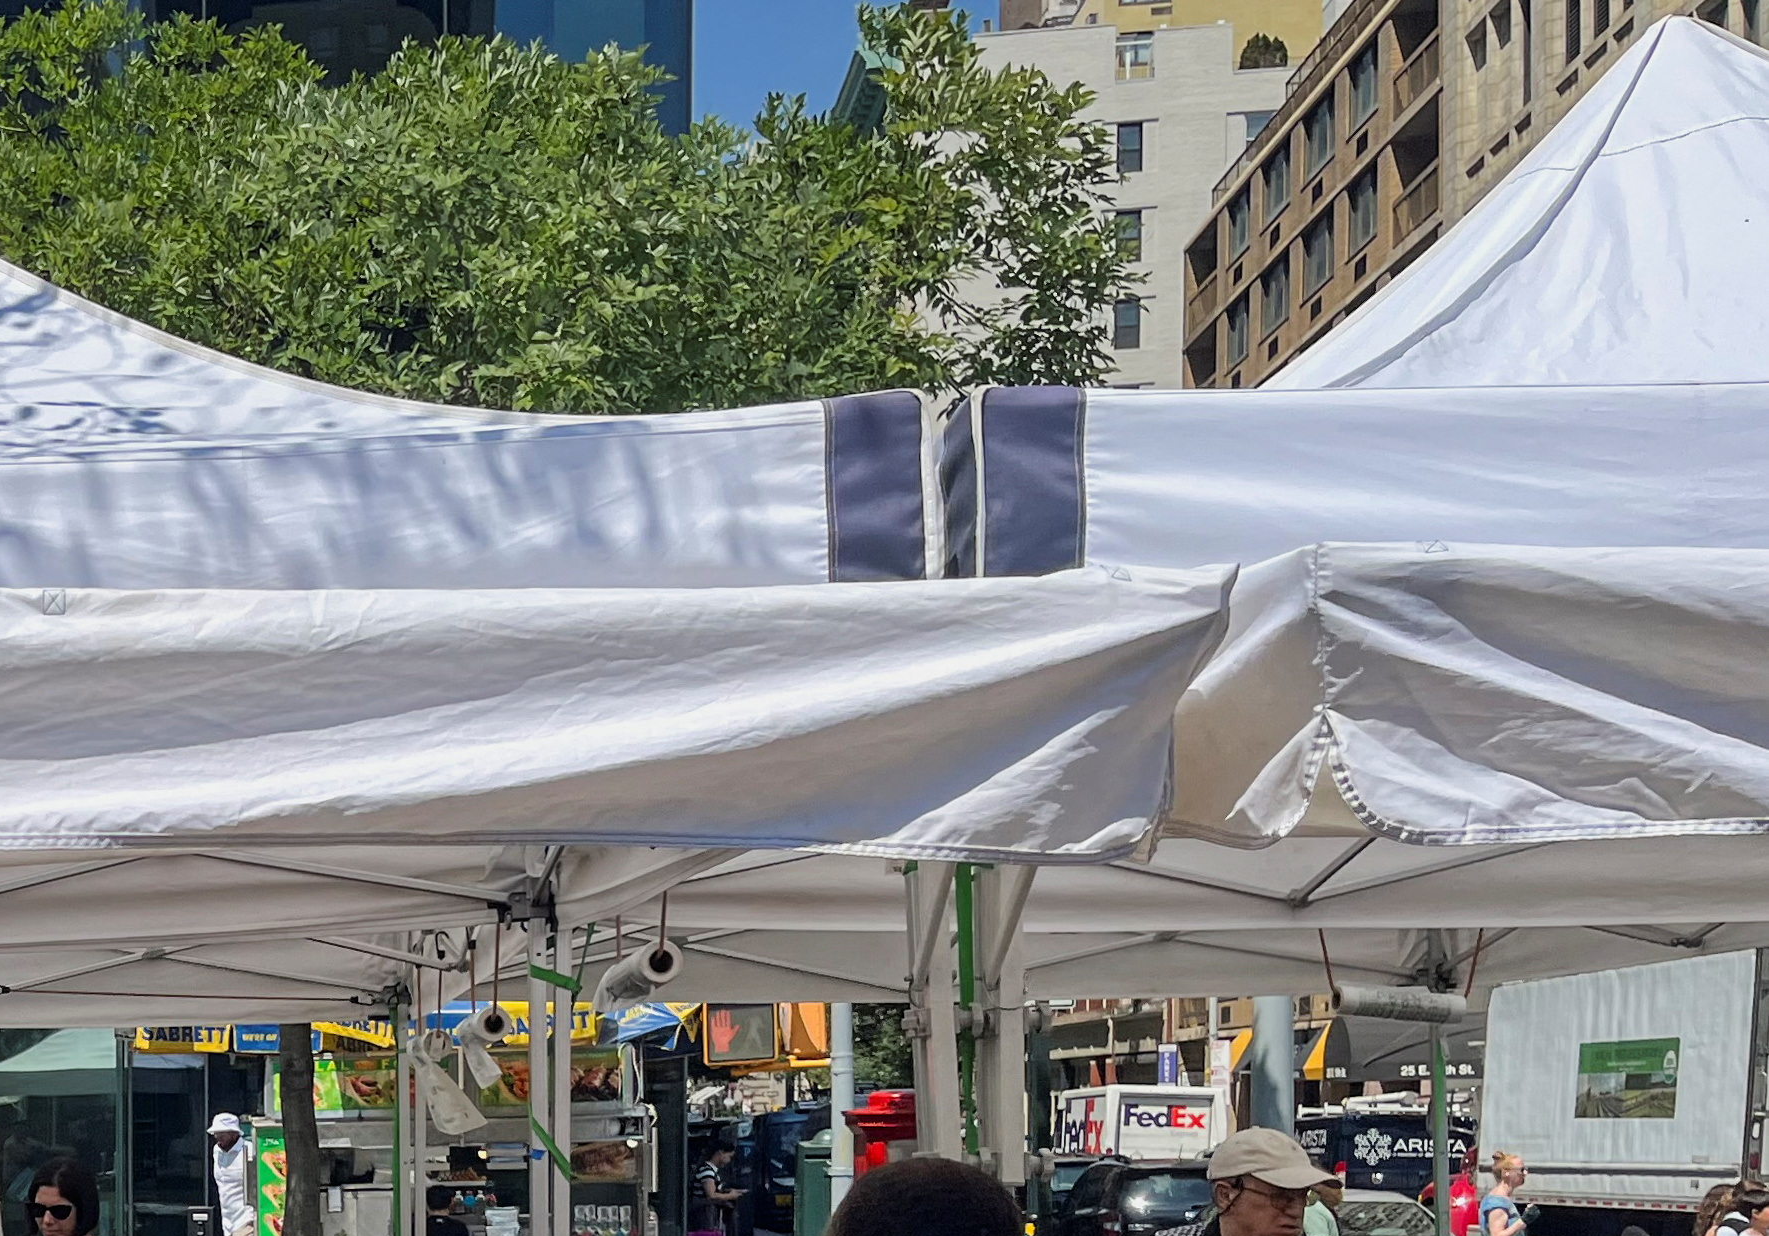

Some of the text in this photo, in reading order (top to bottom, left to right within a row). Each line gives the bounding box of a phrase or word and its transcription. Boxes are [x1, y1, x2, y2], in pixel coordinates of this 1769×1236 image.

[142, 1026, 226, 1043] SABRETT
[1400, 1065, 1416, 1077] 25
[1459, 1063, 1475, 1075] St.
[1123, 1103, 1206, 1129] FedEx
